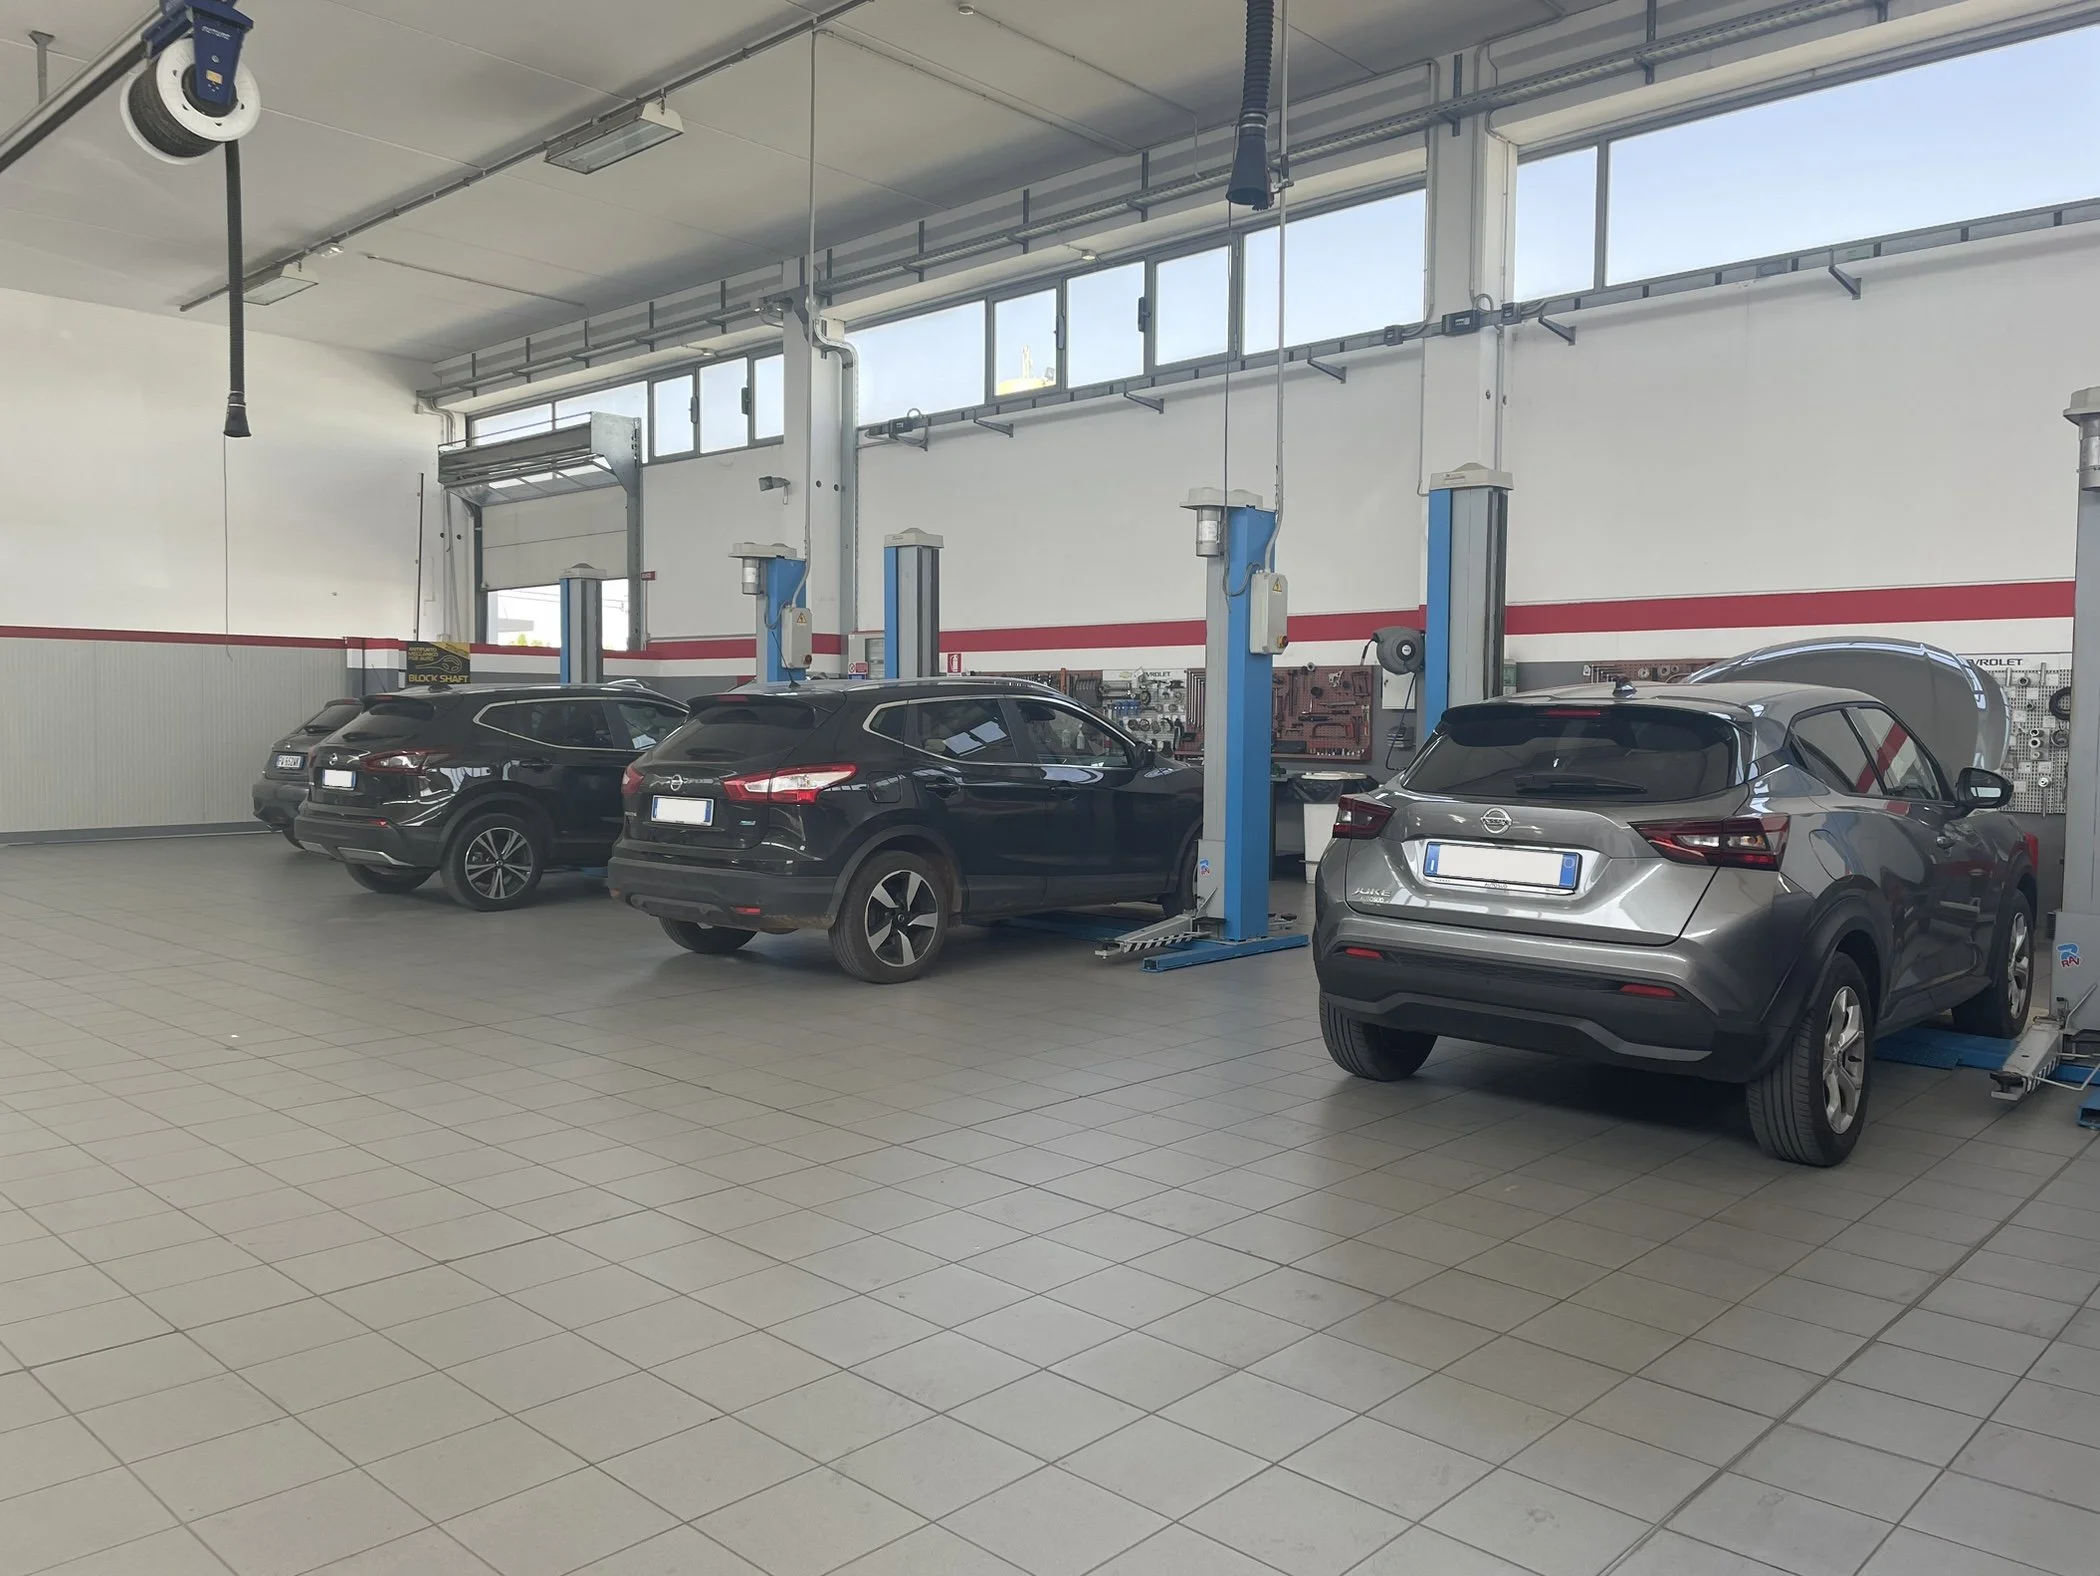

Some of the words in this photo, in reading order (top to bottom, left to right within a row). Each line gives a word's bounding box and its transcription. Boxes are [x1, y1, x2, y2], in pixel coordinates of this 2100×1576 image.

[408, 674, 438, 682] BLOCK
[440, 675, 469, 683] SHAFT
[1351, 887, 1391, 897] JUKE
[2061, 955, 2080, 967] RAV
